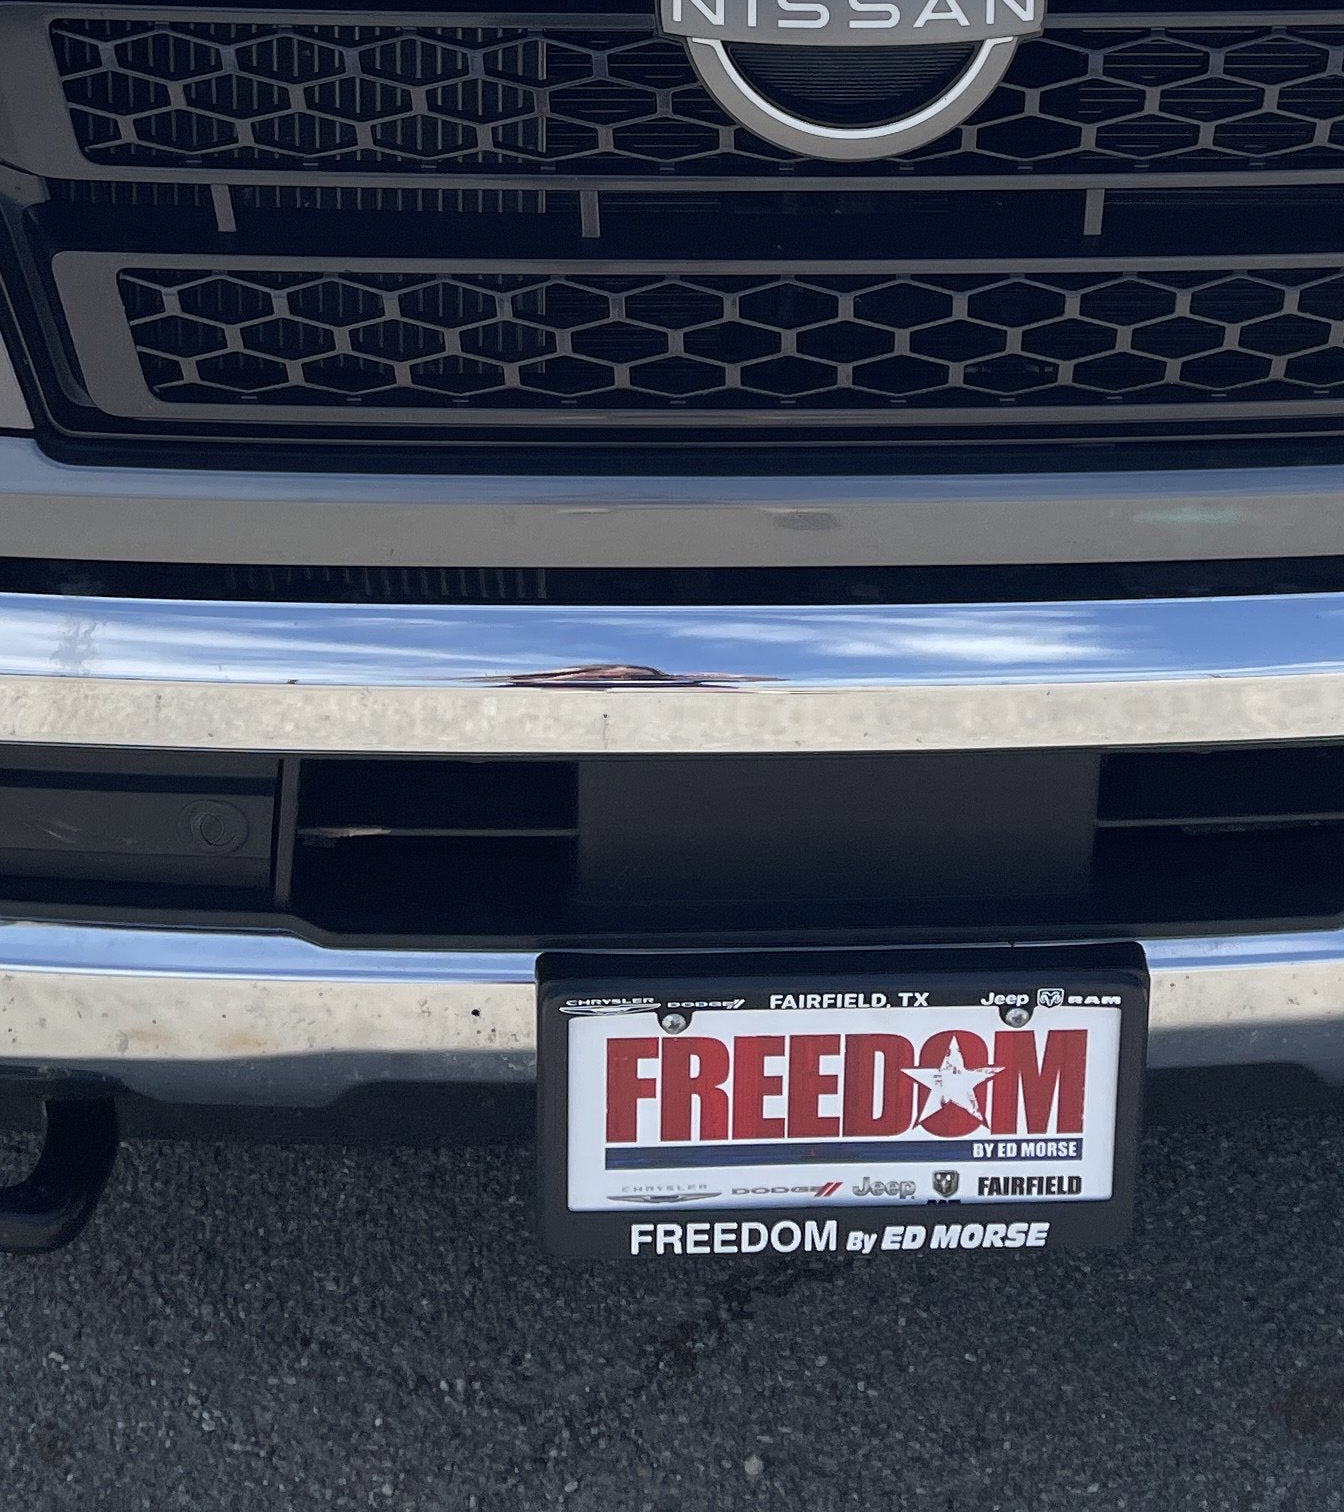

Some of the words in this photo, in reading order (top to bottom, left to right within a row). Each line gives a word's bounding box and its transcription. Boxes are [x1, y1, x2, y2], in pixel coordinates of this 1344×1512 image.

[565, 996, 655, 1007] CHRYSLER
[769, 992, 892, 1009] FAIRFIELD,
[898, 991, 930, 1008] TX
[980, 991, 1030, 1007] Jeep
[1067, 994, 1122, 1005] RAM
[605, 1028, 1089, 1144] FREEDOM
[972, 1141, 994, 1159] BY
[997, 1141, 1019, 1158] ED
[1020, 1140, 1078, 1158] MORSE
[852, 1176, 916, 1199] Jeep
[977, 1175, 1082, 1196] FAIRFIELD
[630, 1219, 838, 1256] FREEDOM
[846, 1230, 877, 1254] By
[880, 1225, 927, 1251] ED
[929, 1221, 1051, 1250] MORSE
